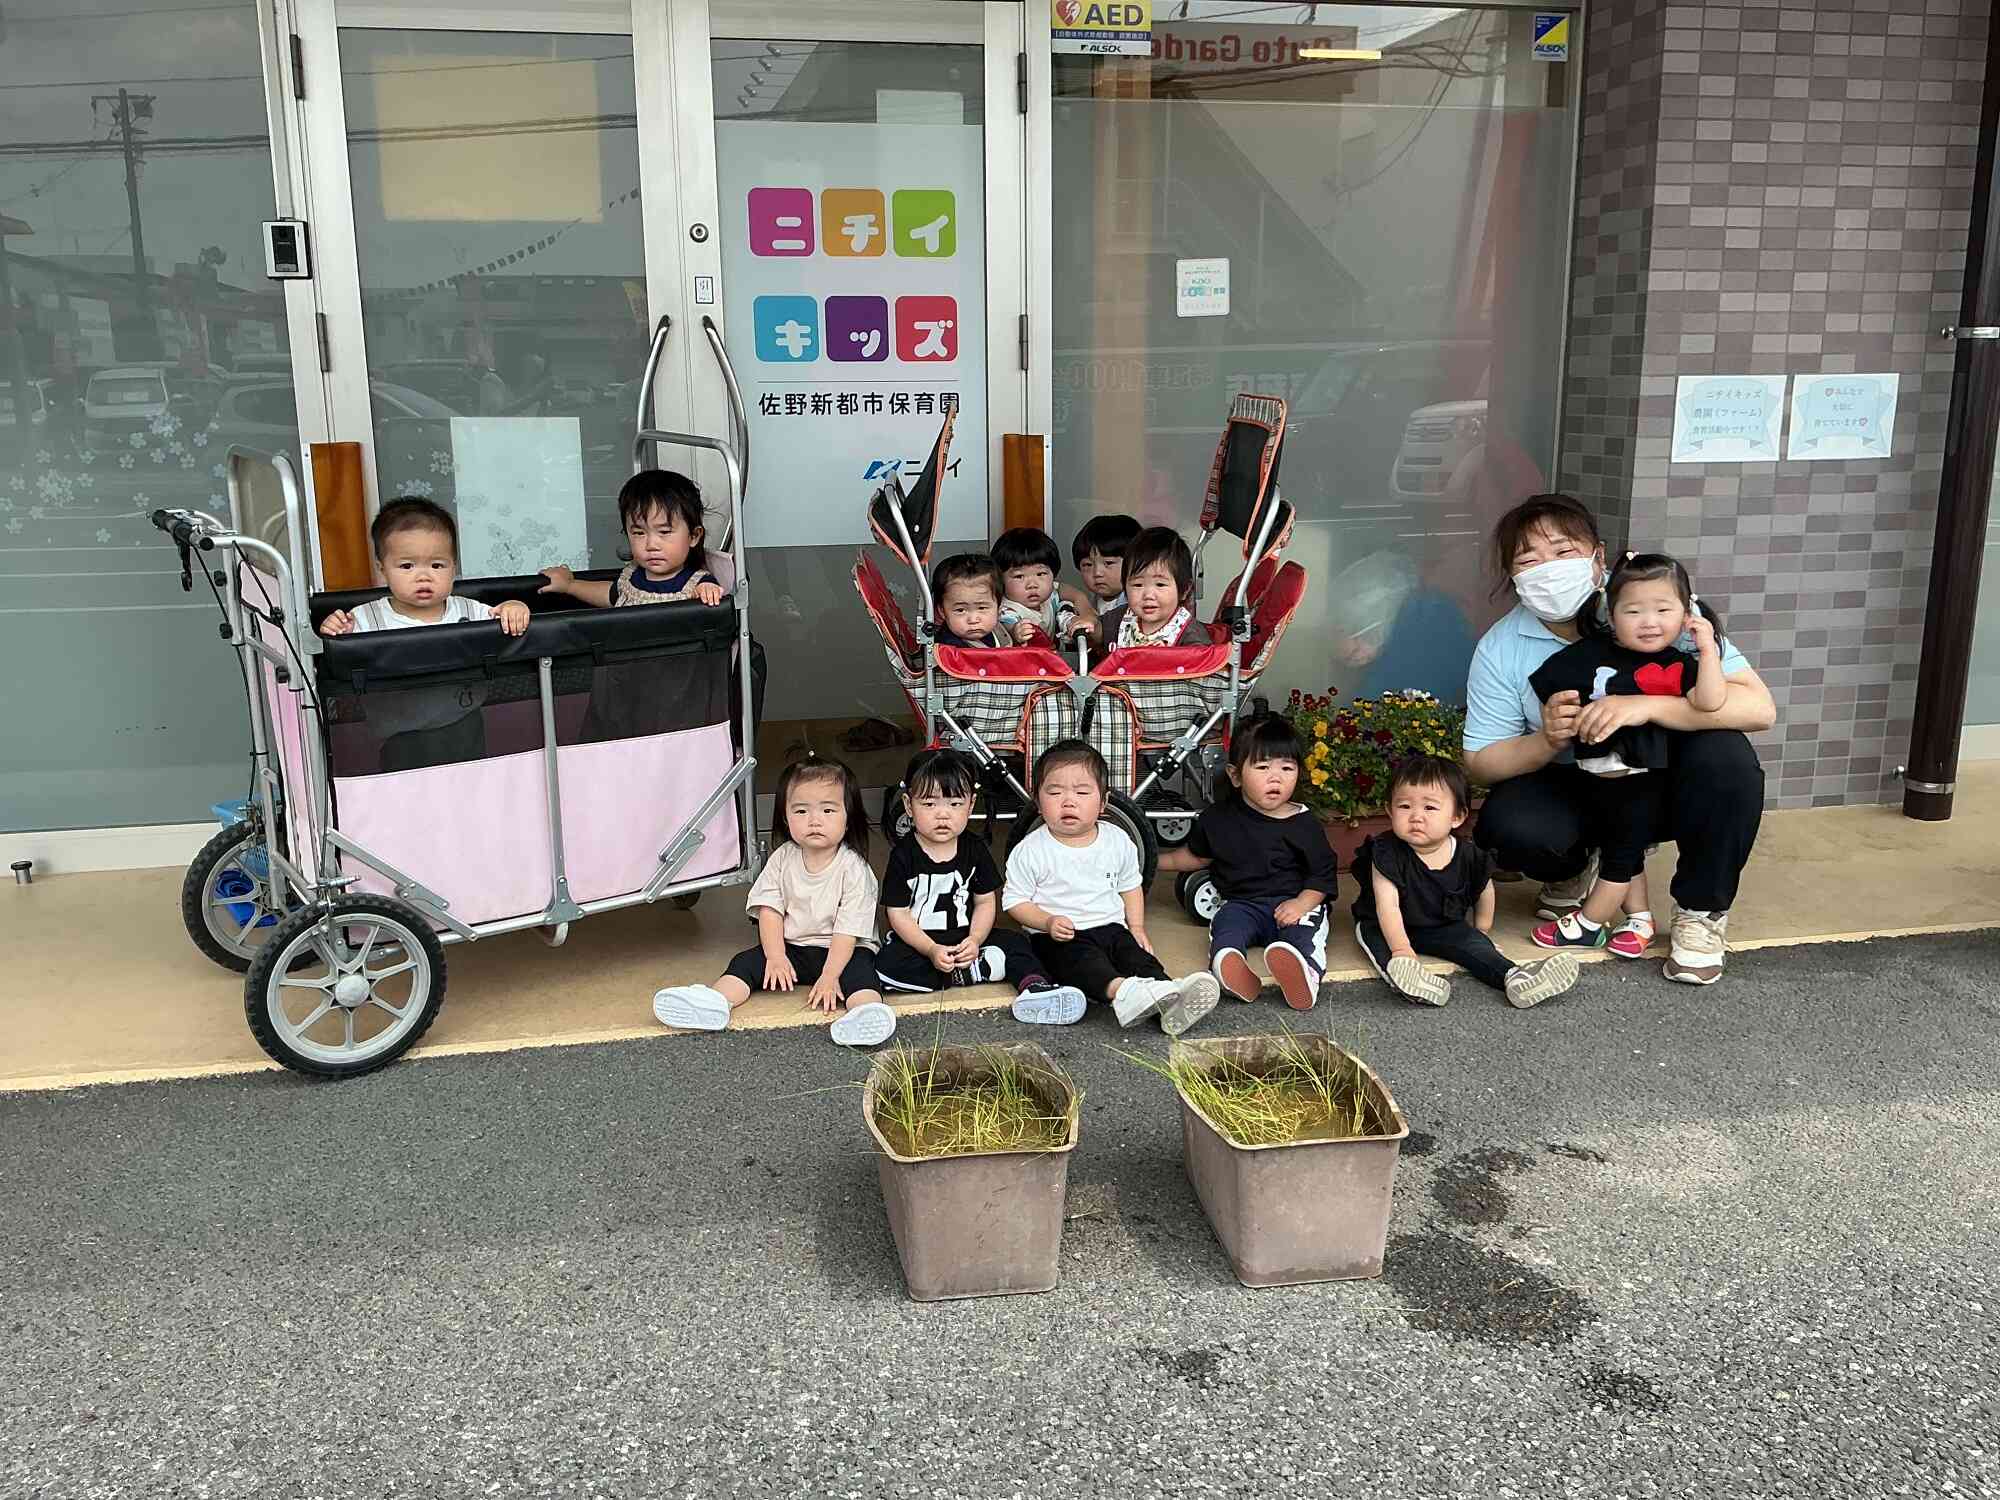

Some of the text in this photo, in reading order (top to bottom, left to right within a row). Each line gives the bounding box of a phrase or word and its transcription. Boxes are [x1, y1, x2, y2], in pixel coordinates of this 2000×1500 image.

[1084, 3, 1144, 26] AED
[1089, 44, 1122, 53] ALSOK
[770, 213, 951, 253] ニチイ
[774, 318, 955, 359] キッズ
[758, 391, 960, 416] 佐野新都市保育園
[904, 457, 961, 478] ニイ
